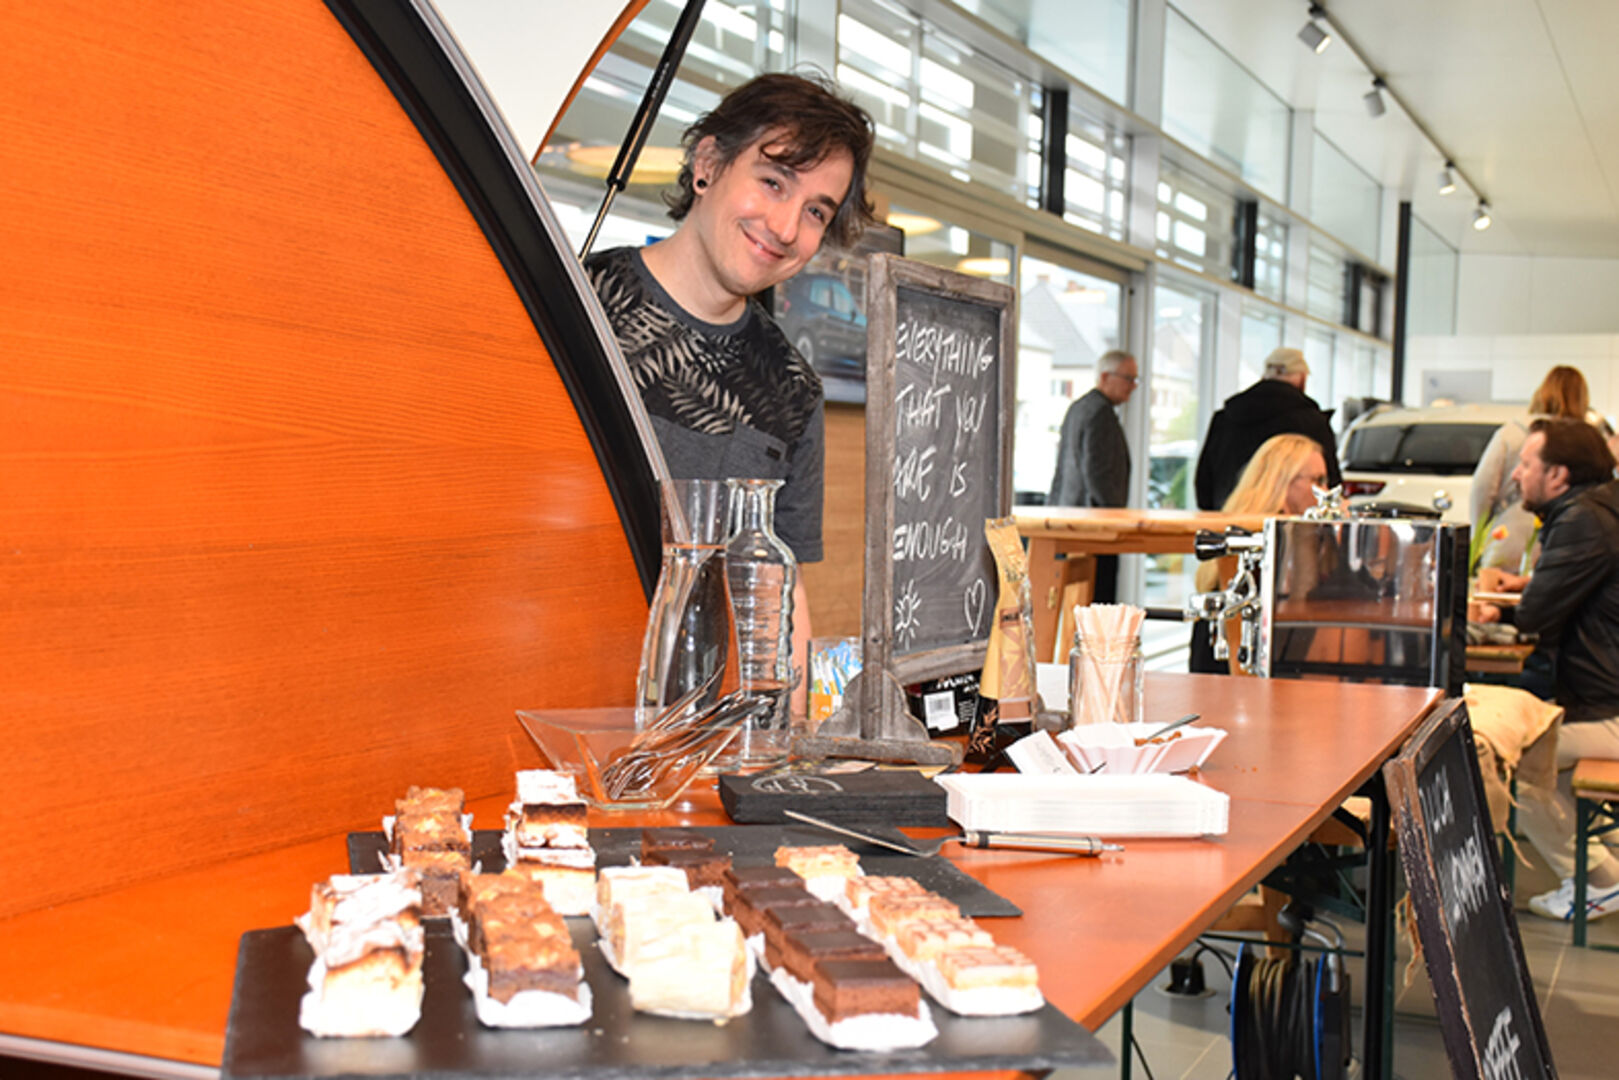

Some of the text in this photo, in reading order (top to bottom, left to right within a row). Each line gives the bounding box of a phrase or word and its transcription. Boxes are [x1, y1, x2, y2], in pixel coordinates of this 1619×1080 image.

[895, 319, 994, 386] EVERYTHING
[895, 382, 988, 452] THAT YOU
[893, 445, 968, 501] ARE IS
[892, 516, 968, 562] ENOUGH
